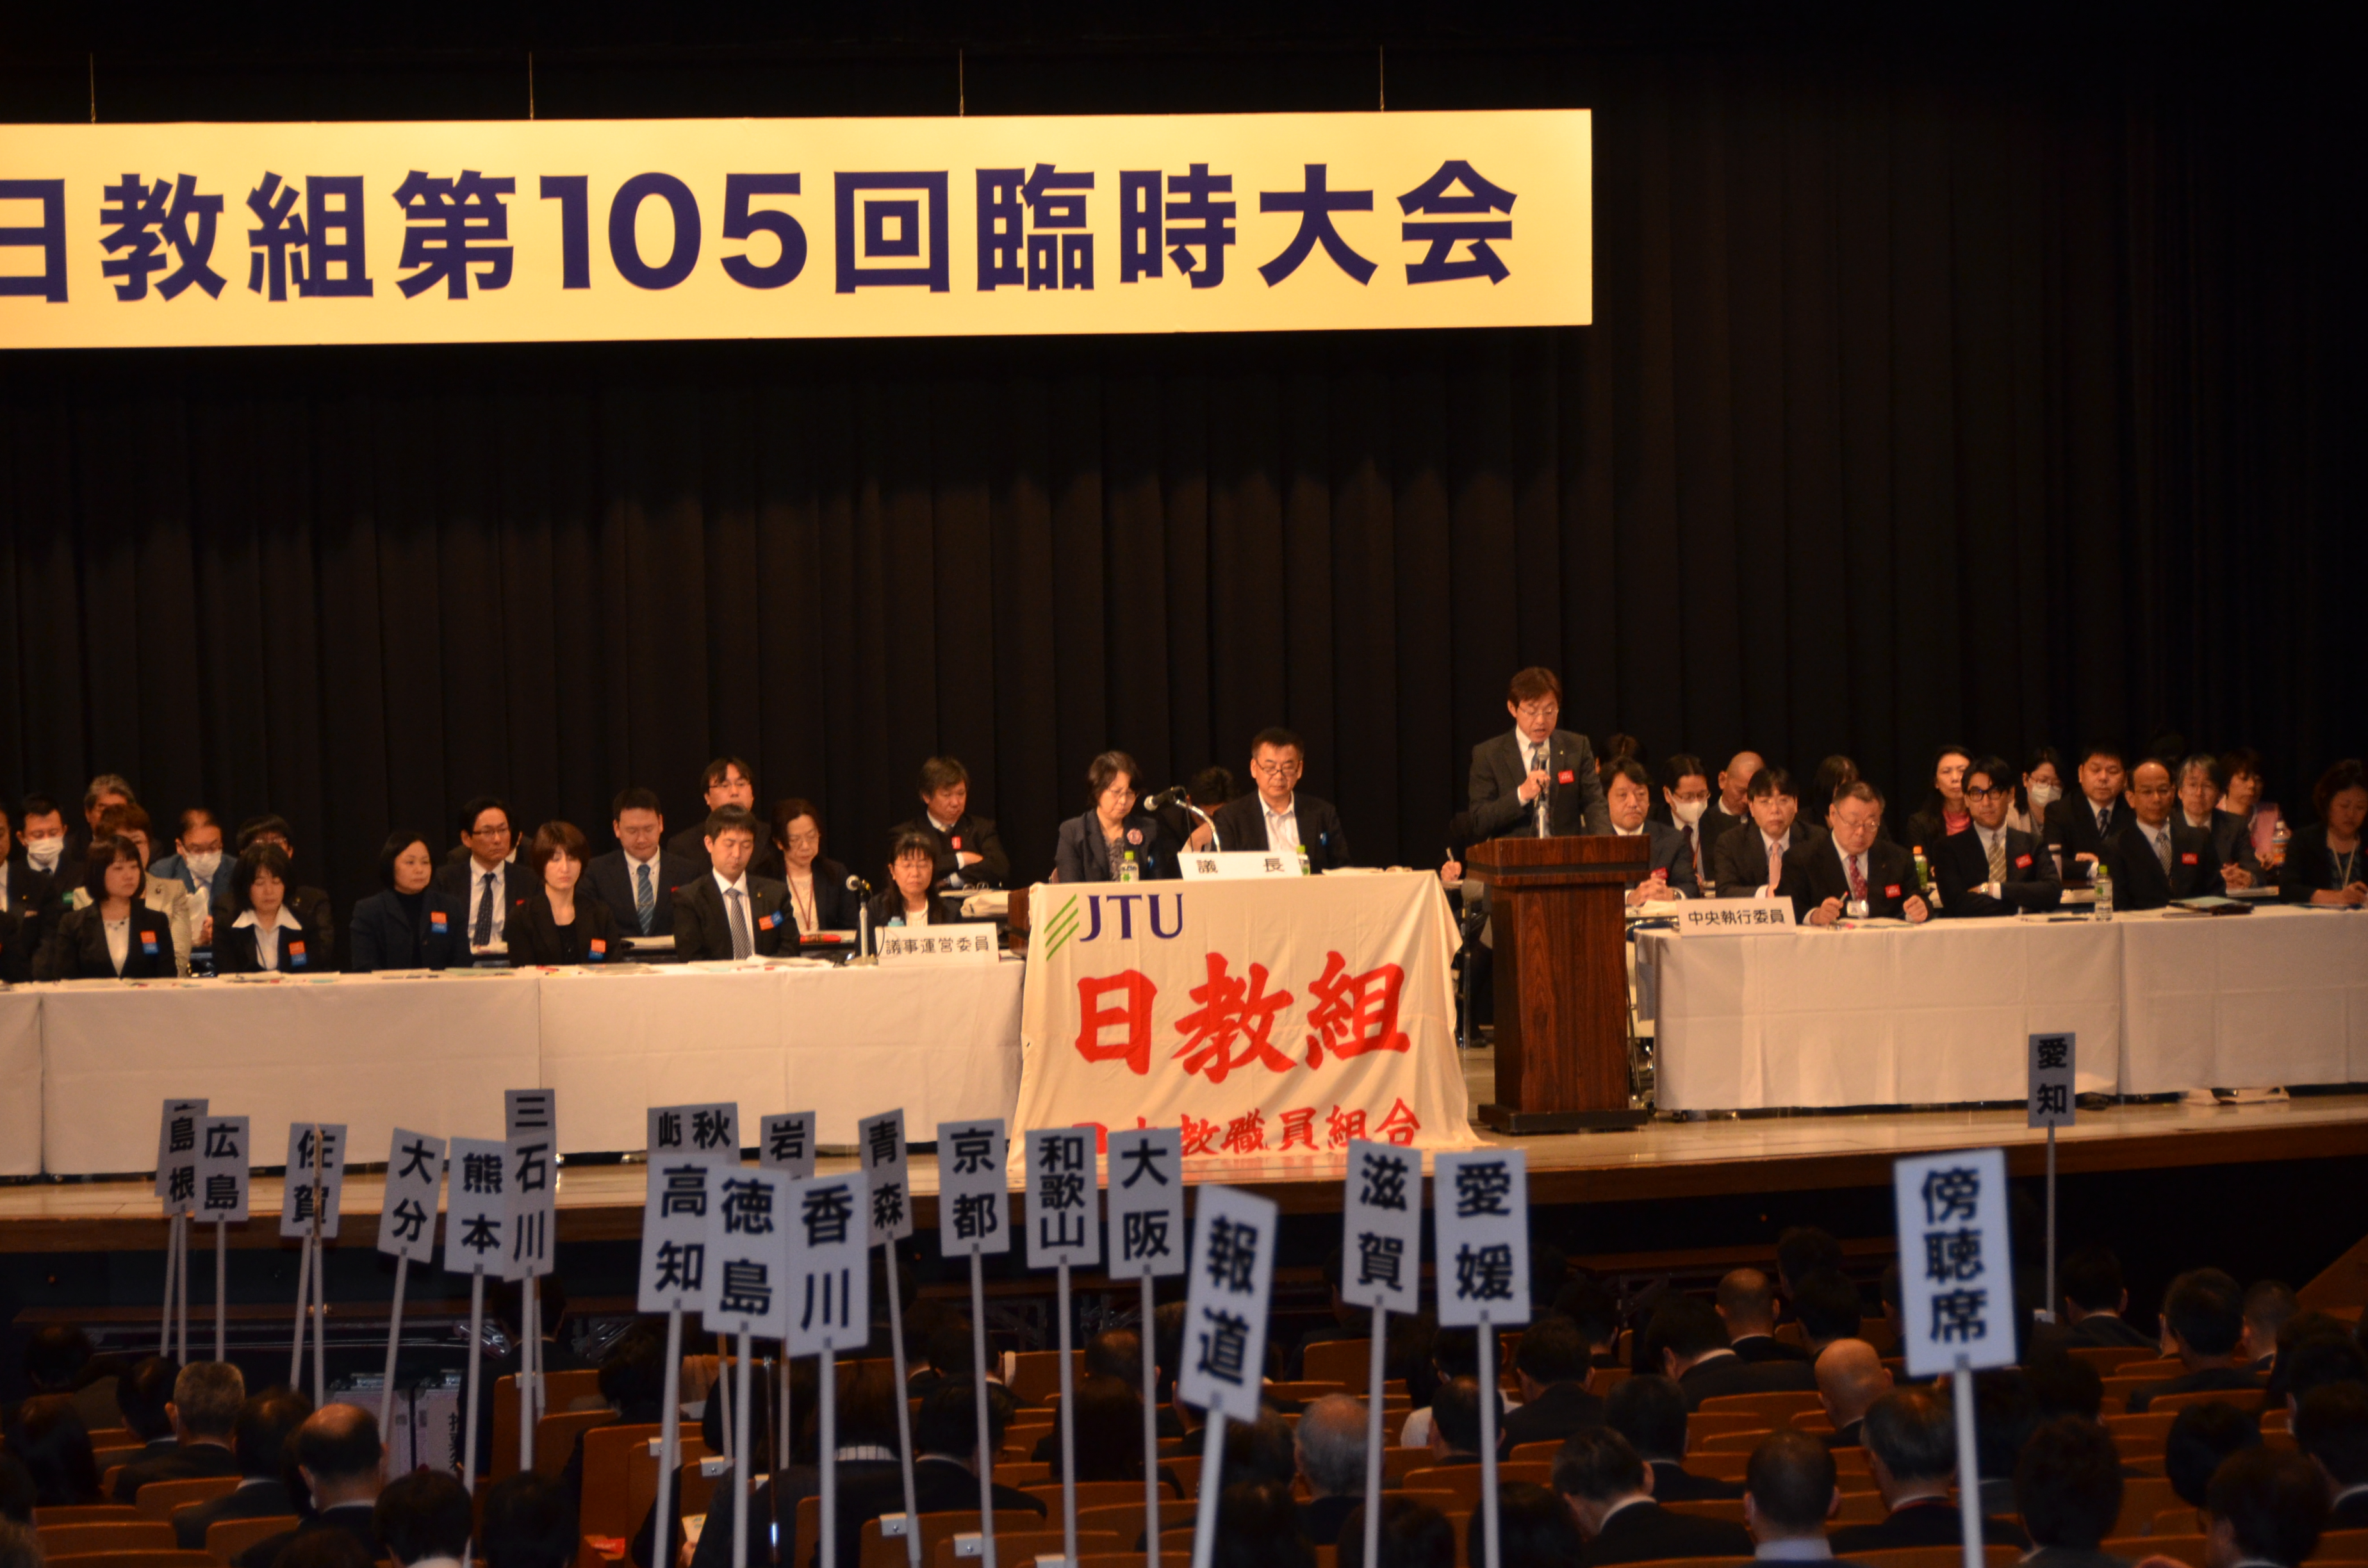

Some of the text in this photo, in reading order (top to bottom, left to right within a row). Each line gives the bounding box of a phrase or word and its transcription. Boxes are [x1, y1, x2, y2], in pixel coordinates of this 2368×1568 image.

[0, 159, 1518, 303] 日教組第105回臨時大会
[885, 936, 989, 955] 議事運営委員
[1080, 893, 1183, 942] JTU
[1688, 908, 1786, 926] 中央執行委員
[1074, 951, 1411, 1084] 日教組
[1071, 1098, 1420, 1157] 教職員組合
[2037, 1037, 2068, 1116] 愛知
[169, 1116, 195, 1203] 島根
[204, 1123, 240, 1211] 広島
[292, 1129, 336, 1223] 佐賀
[391, 1138, 435, 1242] 大分
[460, 1152, 503, 1255] 熊本
[513, 1143, 548, 1262] 石川
[770, 1120, 805, 1180] 岩
[868, 1120, 904, 1230] 青森
[951, 1127, 998, 1240] 京都
[1039, 1135, 1085, 1250] 和歌山
[1121, 1138, 1171, 1261] 大阪
[655, 1164, 708, 1293] 高知
[718, 1178, 775, 1316] 徳島
[801, 1184, 853, 1332] 香川
[1356, 1152, 1410, 1292] 滋賀
[1455, 1160, 1513, 1302] 愛媛
[1921, 1166, 1989, 1344] 傍聴席
[1197, 1214, 1258, 1386] 報道
